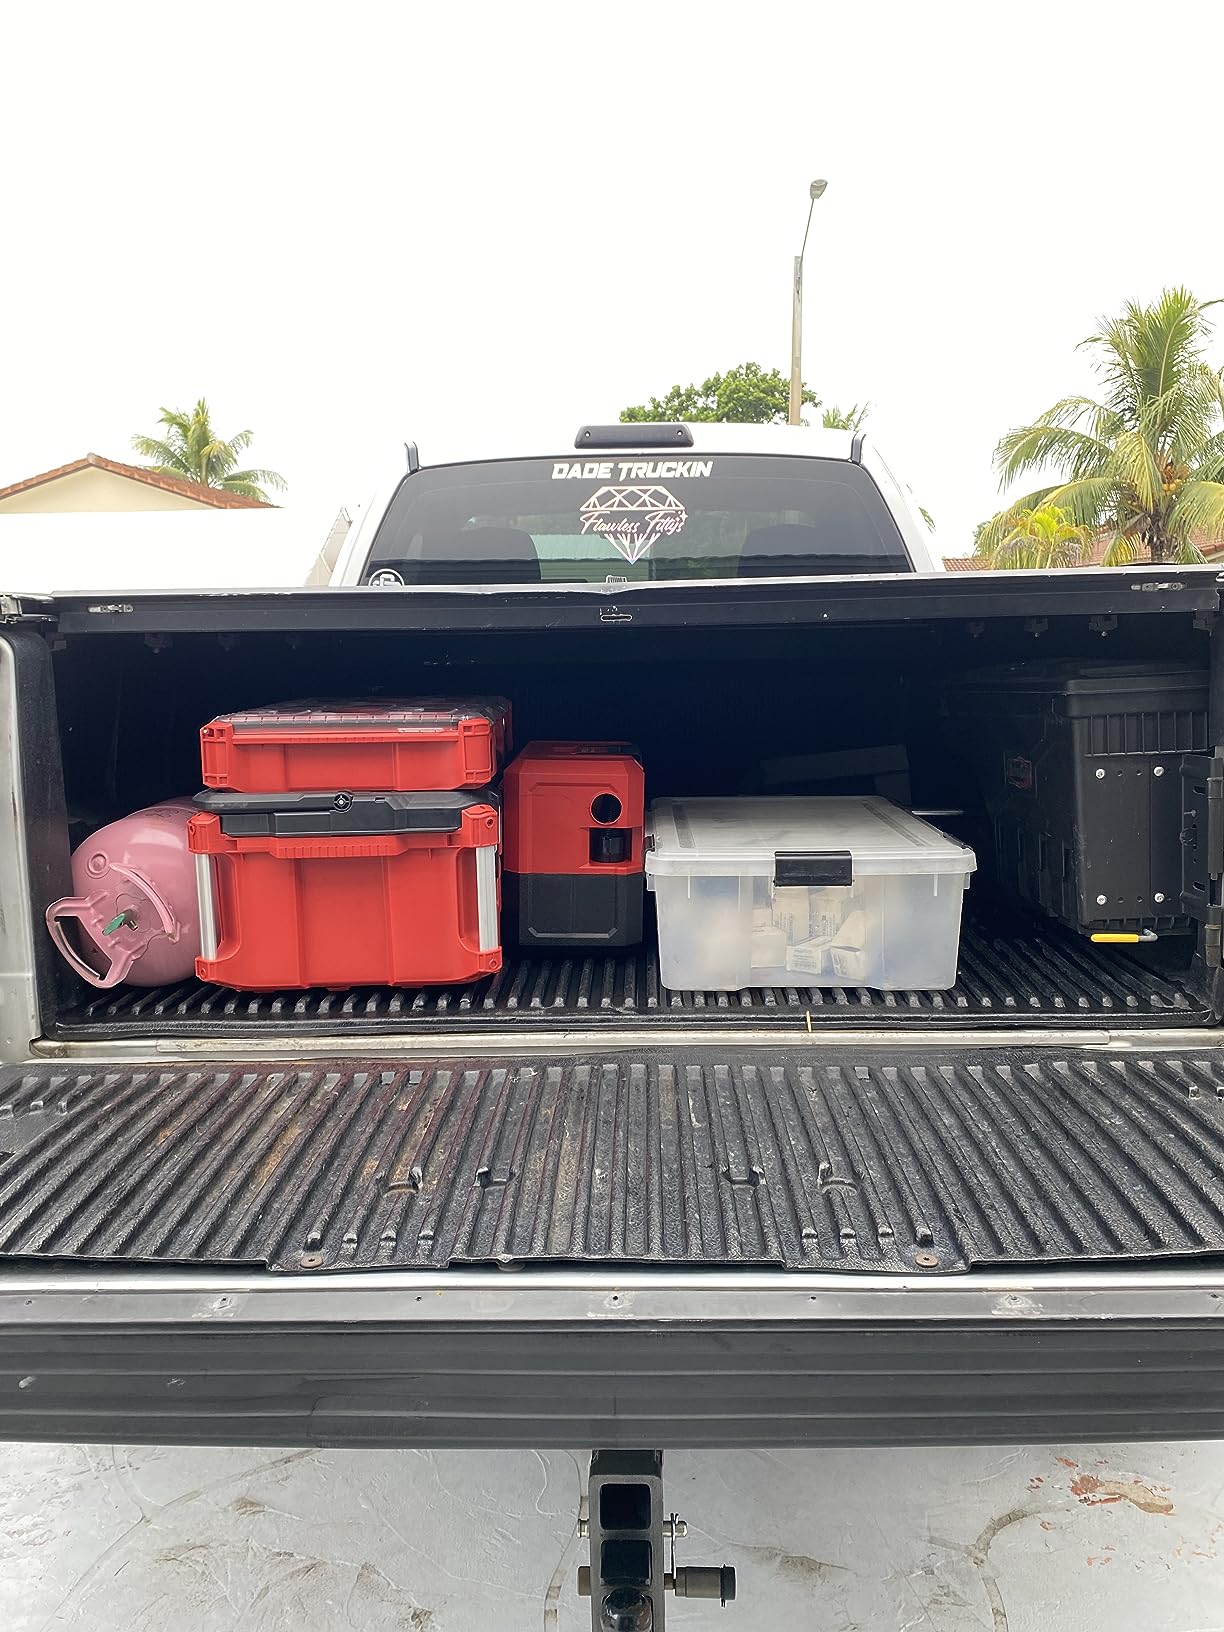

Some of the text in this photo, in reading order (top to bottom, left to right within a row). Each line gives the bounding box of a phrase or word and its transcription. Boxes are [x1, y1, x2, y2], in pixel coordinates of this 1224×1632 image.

[551, 460, 714, 482] DADE TRUCKIN
[579, 510, 640, 535] Flawless
